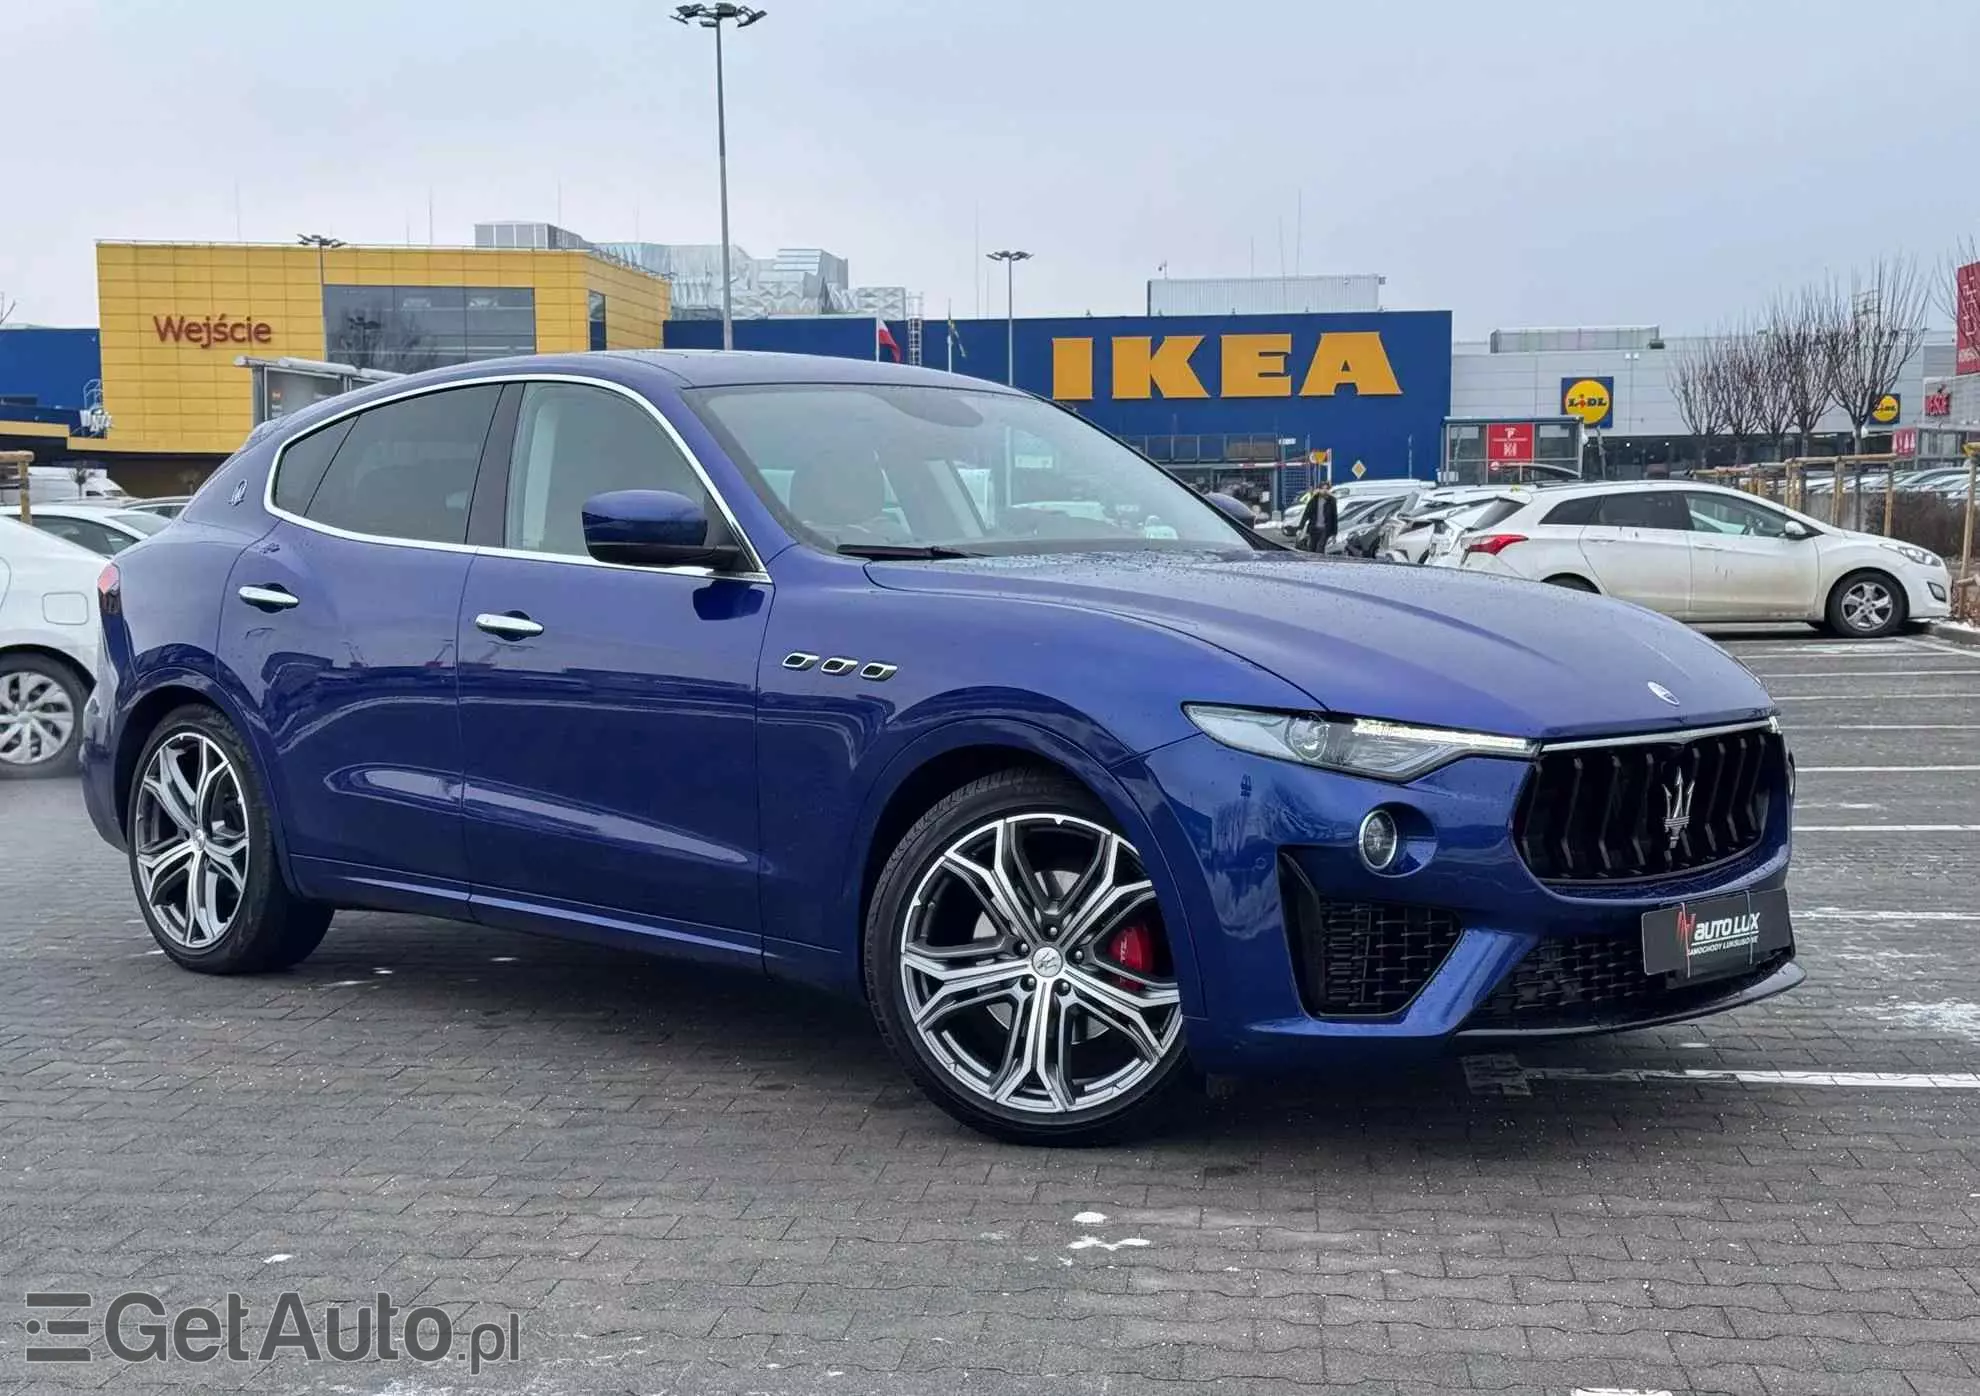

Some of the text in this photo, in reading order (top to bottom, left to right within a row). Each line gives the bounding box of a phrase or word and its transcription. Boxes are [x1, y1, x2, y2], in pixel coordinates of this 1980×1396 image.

[153, 313, 271, 348] Wejście
[1052, 332, 1403, 399] IKEA
[1734, 912, 1760, 933] LUX
